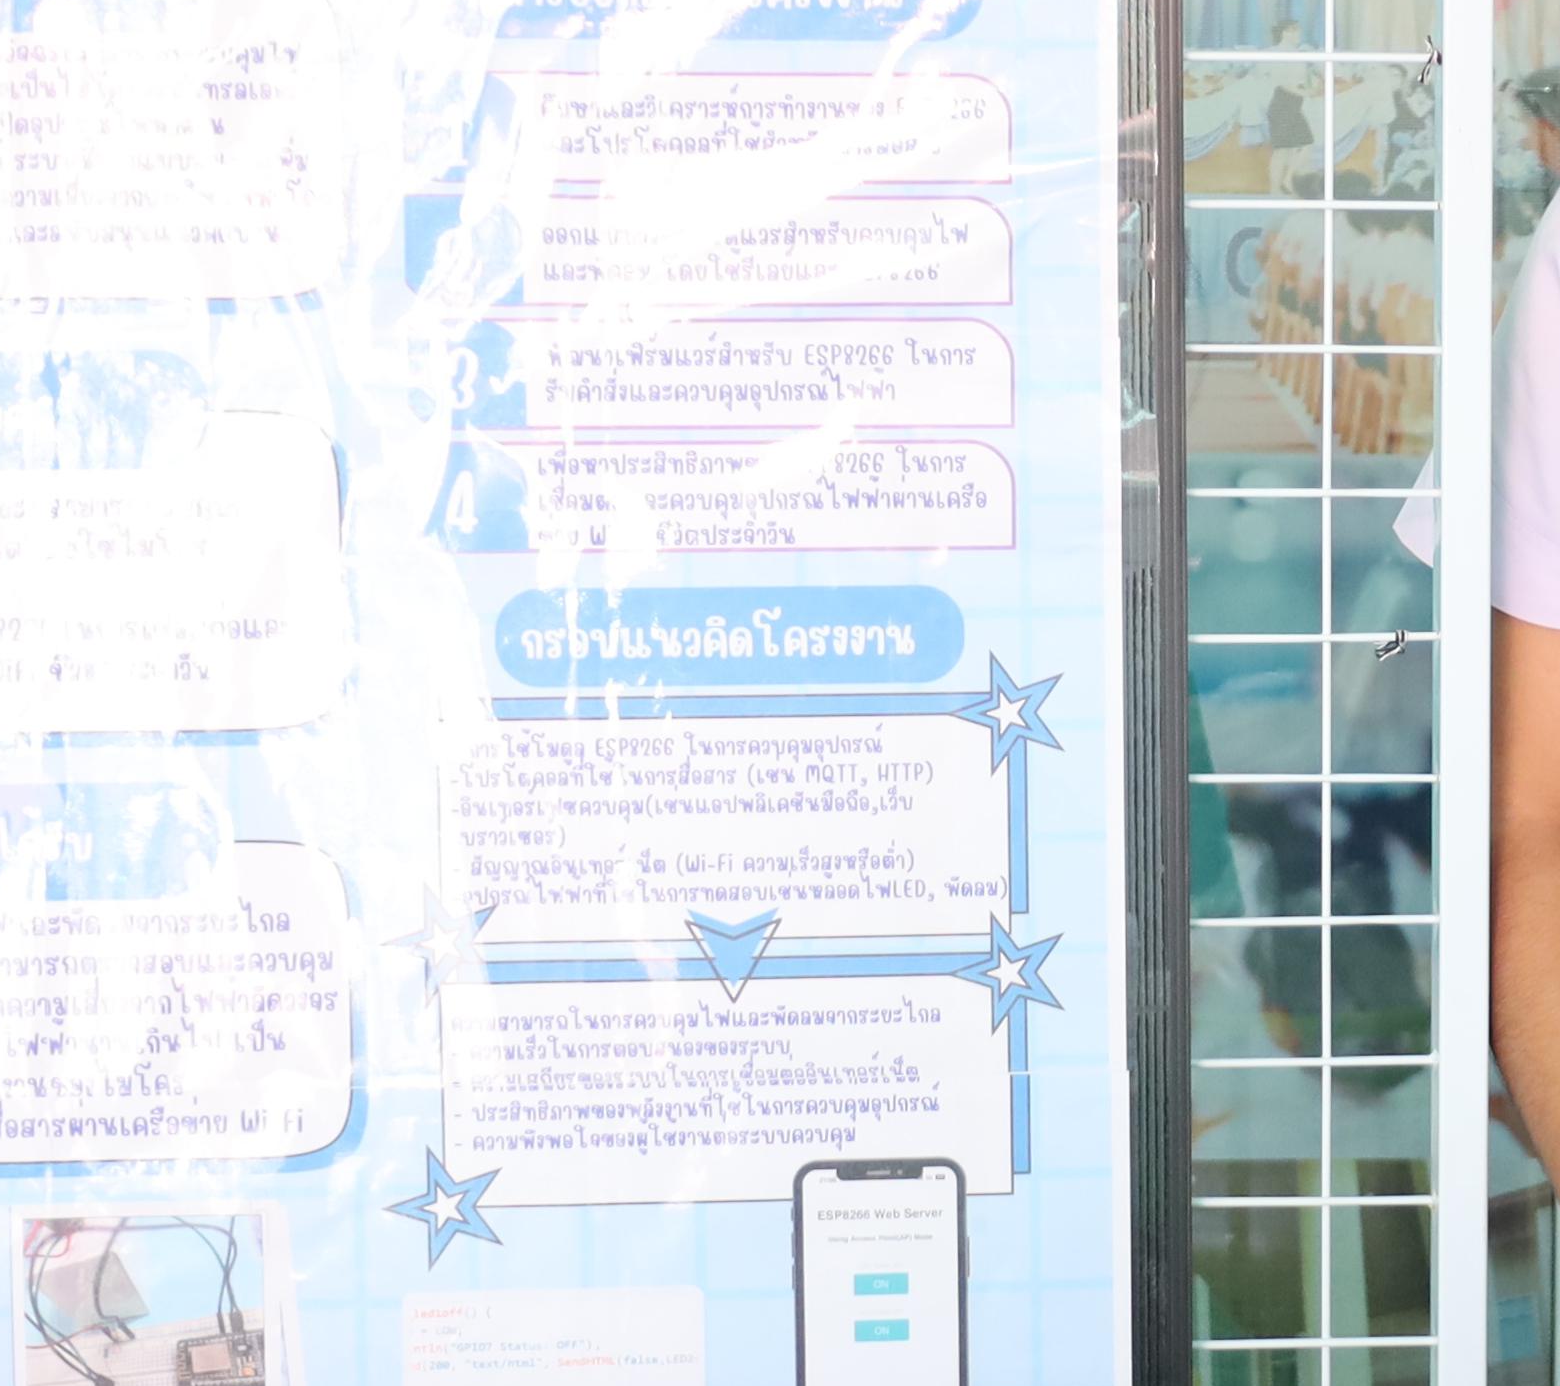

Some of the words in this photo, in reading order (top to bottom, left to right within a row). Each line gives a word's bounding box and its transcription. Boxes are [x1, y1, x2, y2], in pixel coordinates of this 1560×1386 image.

[804, 344, 895, 368] ESP8266
[904, 337, 977, 367] ในการ
[595, 737, 676, 758] ESP8266
[878, 760, 934, 785] HTTP)
[817, 1209, 871, 1221] ESP8266
[874, 1208, 901, 1220] Web
[904, 1207, 943, 1219] Server
